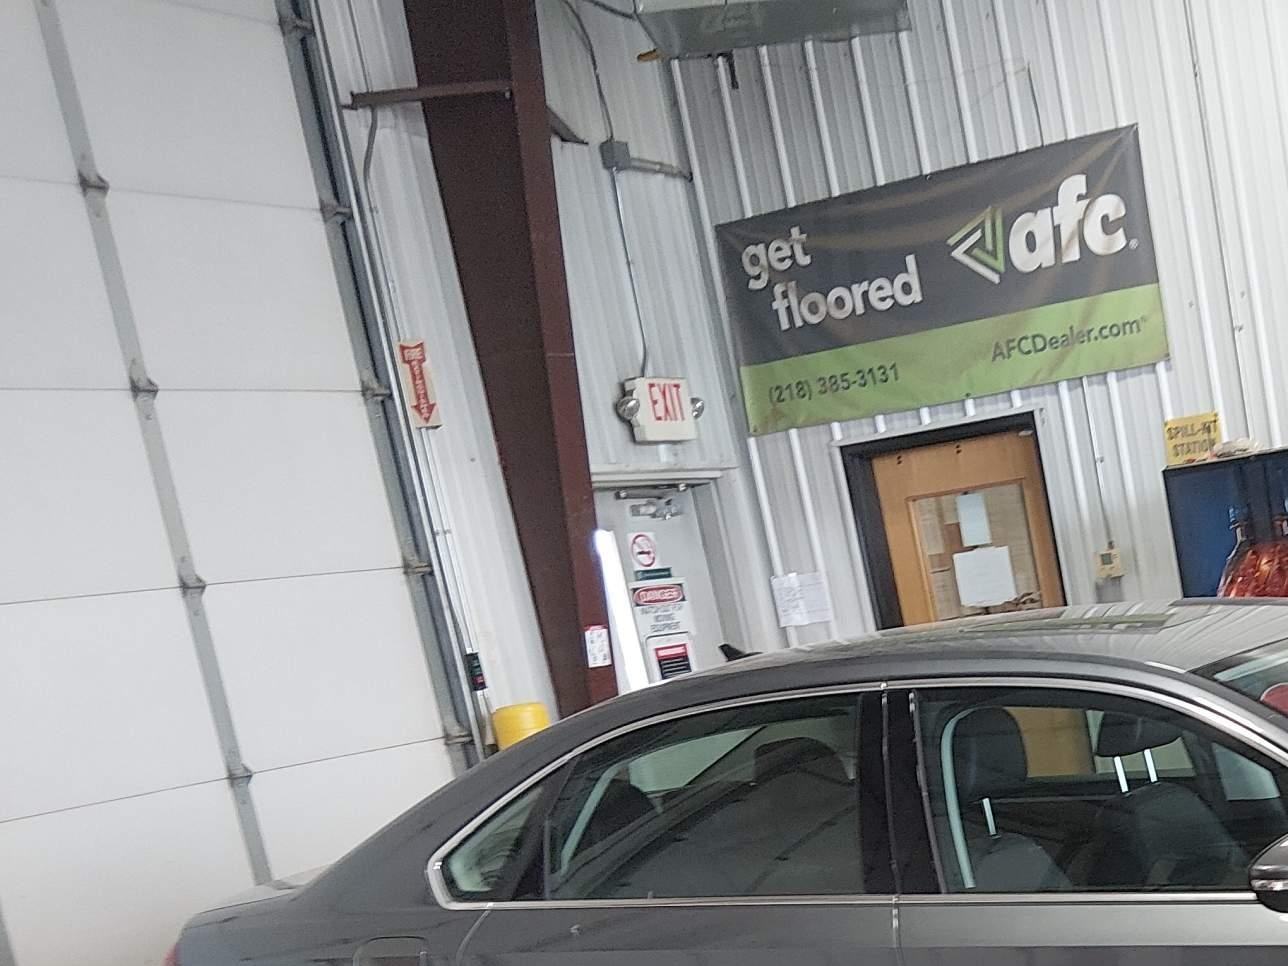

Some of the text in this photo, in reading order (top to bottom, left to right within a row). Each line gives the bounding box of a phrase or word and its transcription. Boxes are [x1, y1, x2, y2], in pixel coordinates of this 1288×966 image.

[1008, 174, 1127, 274] afc
[741, 225, 813, 290] get
[771, 254, 924, 332] floored
[990, 321, 1141, 362] AFCDealer.com
[648, 383, 685, 421] EXIT
[767, 360, 901, 406] (218) 385-3131
